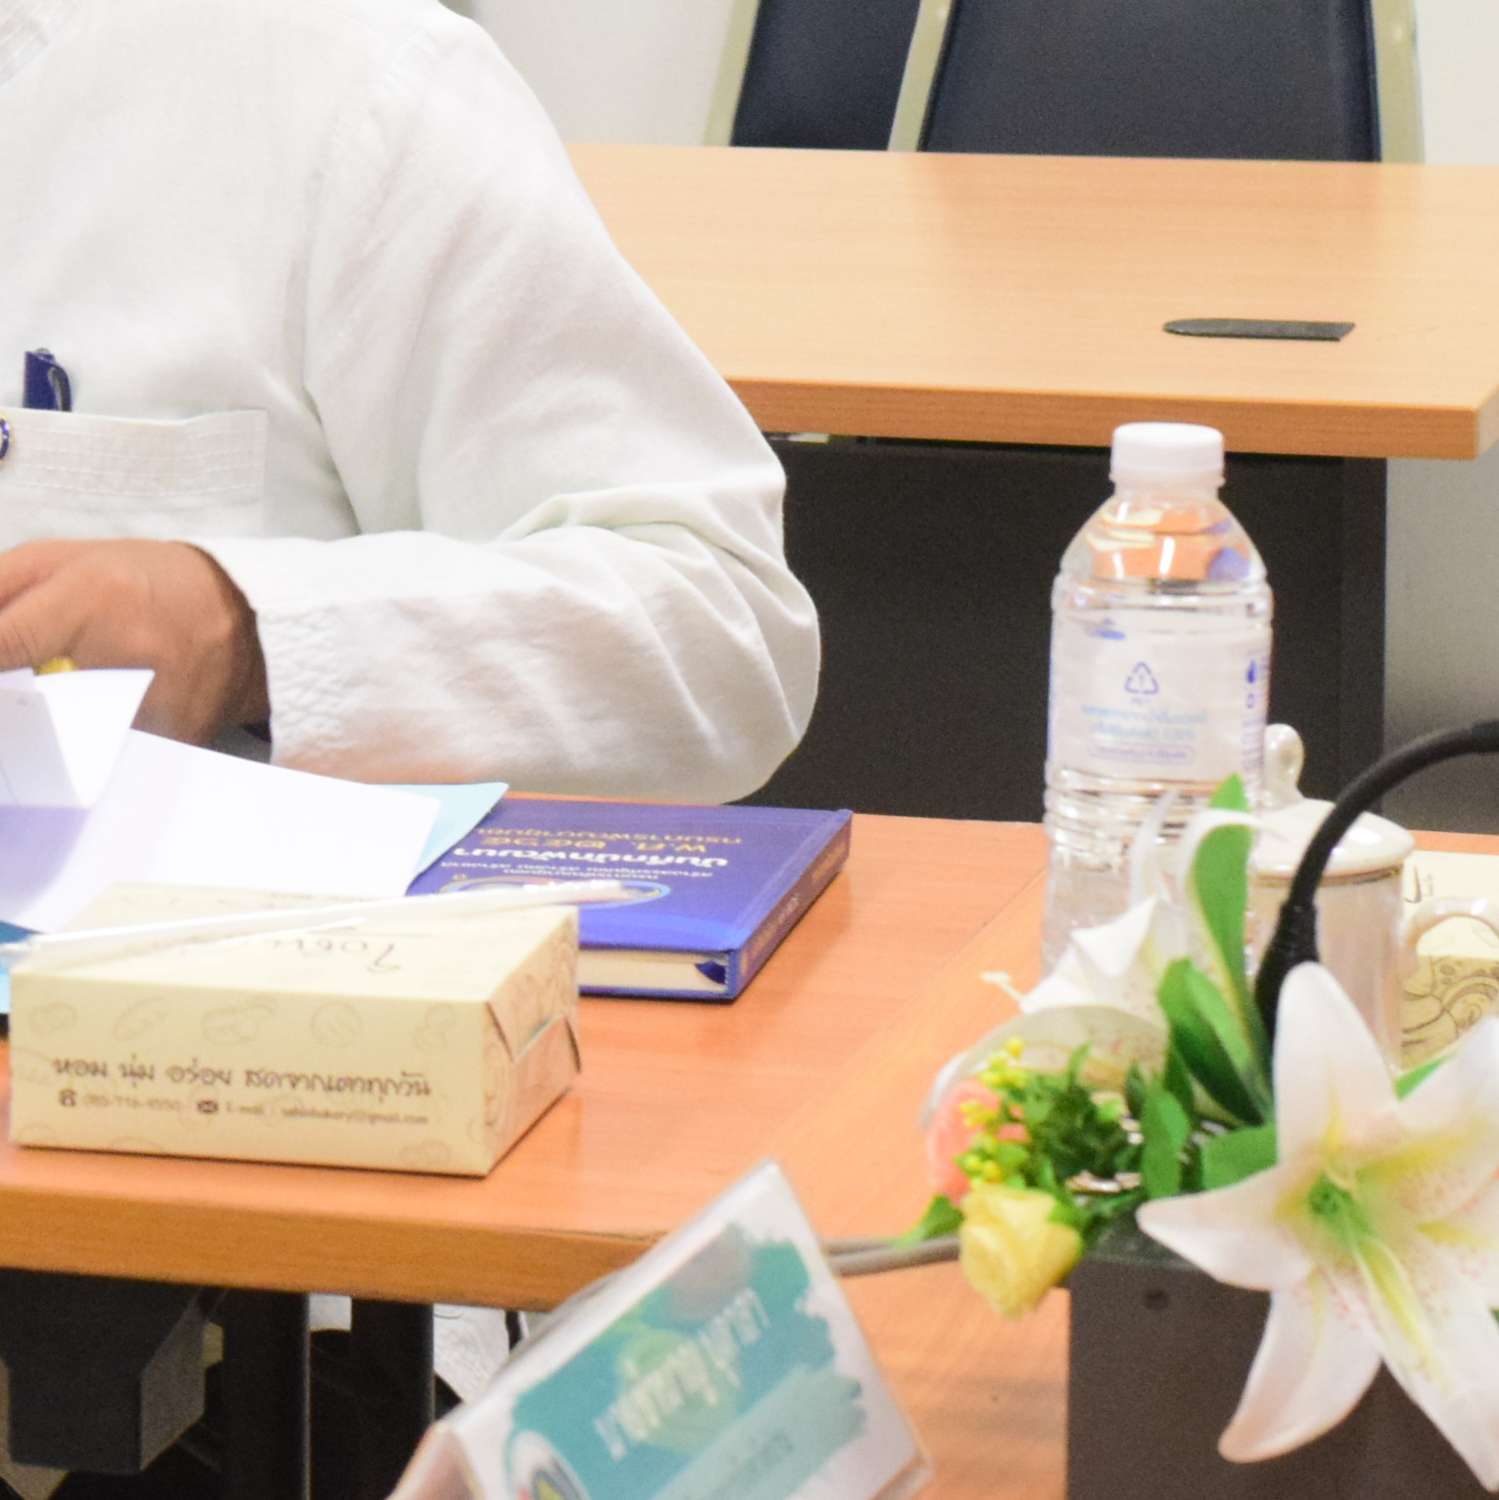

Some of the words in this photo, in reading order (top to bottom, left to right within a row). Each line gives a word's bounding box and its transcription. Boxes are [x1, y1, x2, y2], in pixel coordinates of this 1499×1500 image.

[52, 1056, 109, 1079] หอม
[118, 1053, 156, 1089] นุ่ม
[165, 1057, 234, 1087] อร่อย
